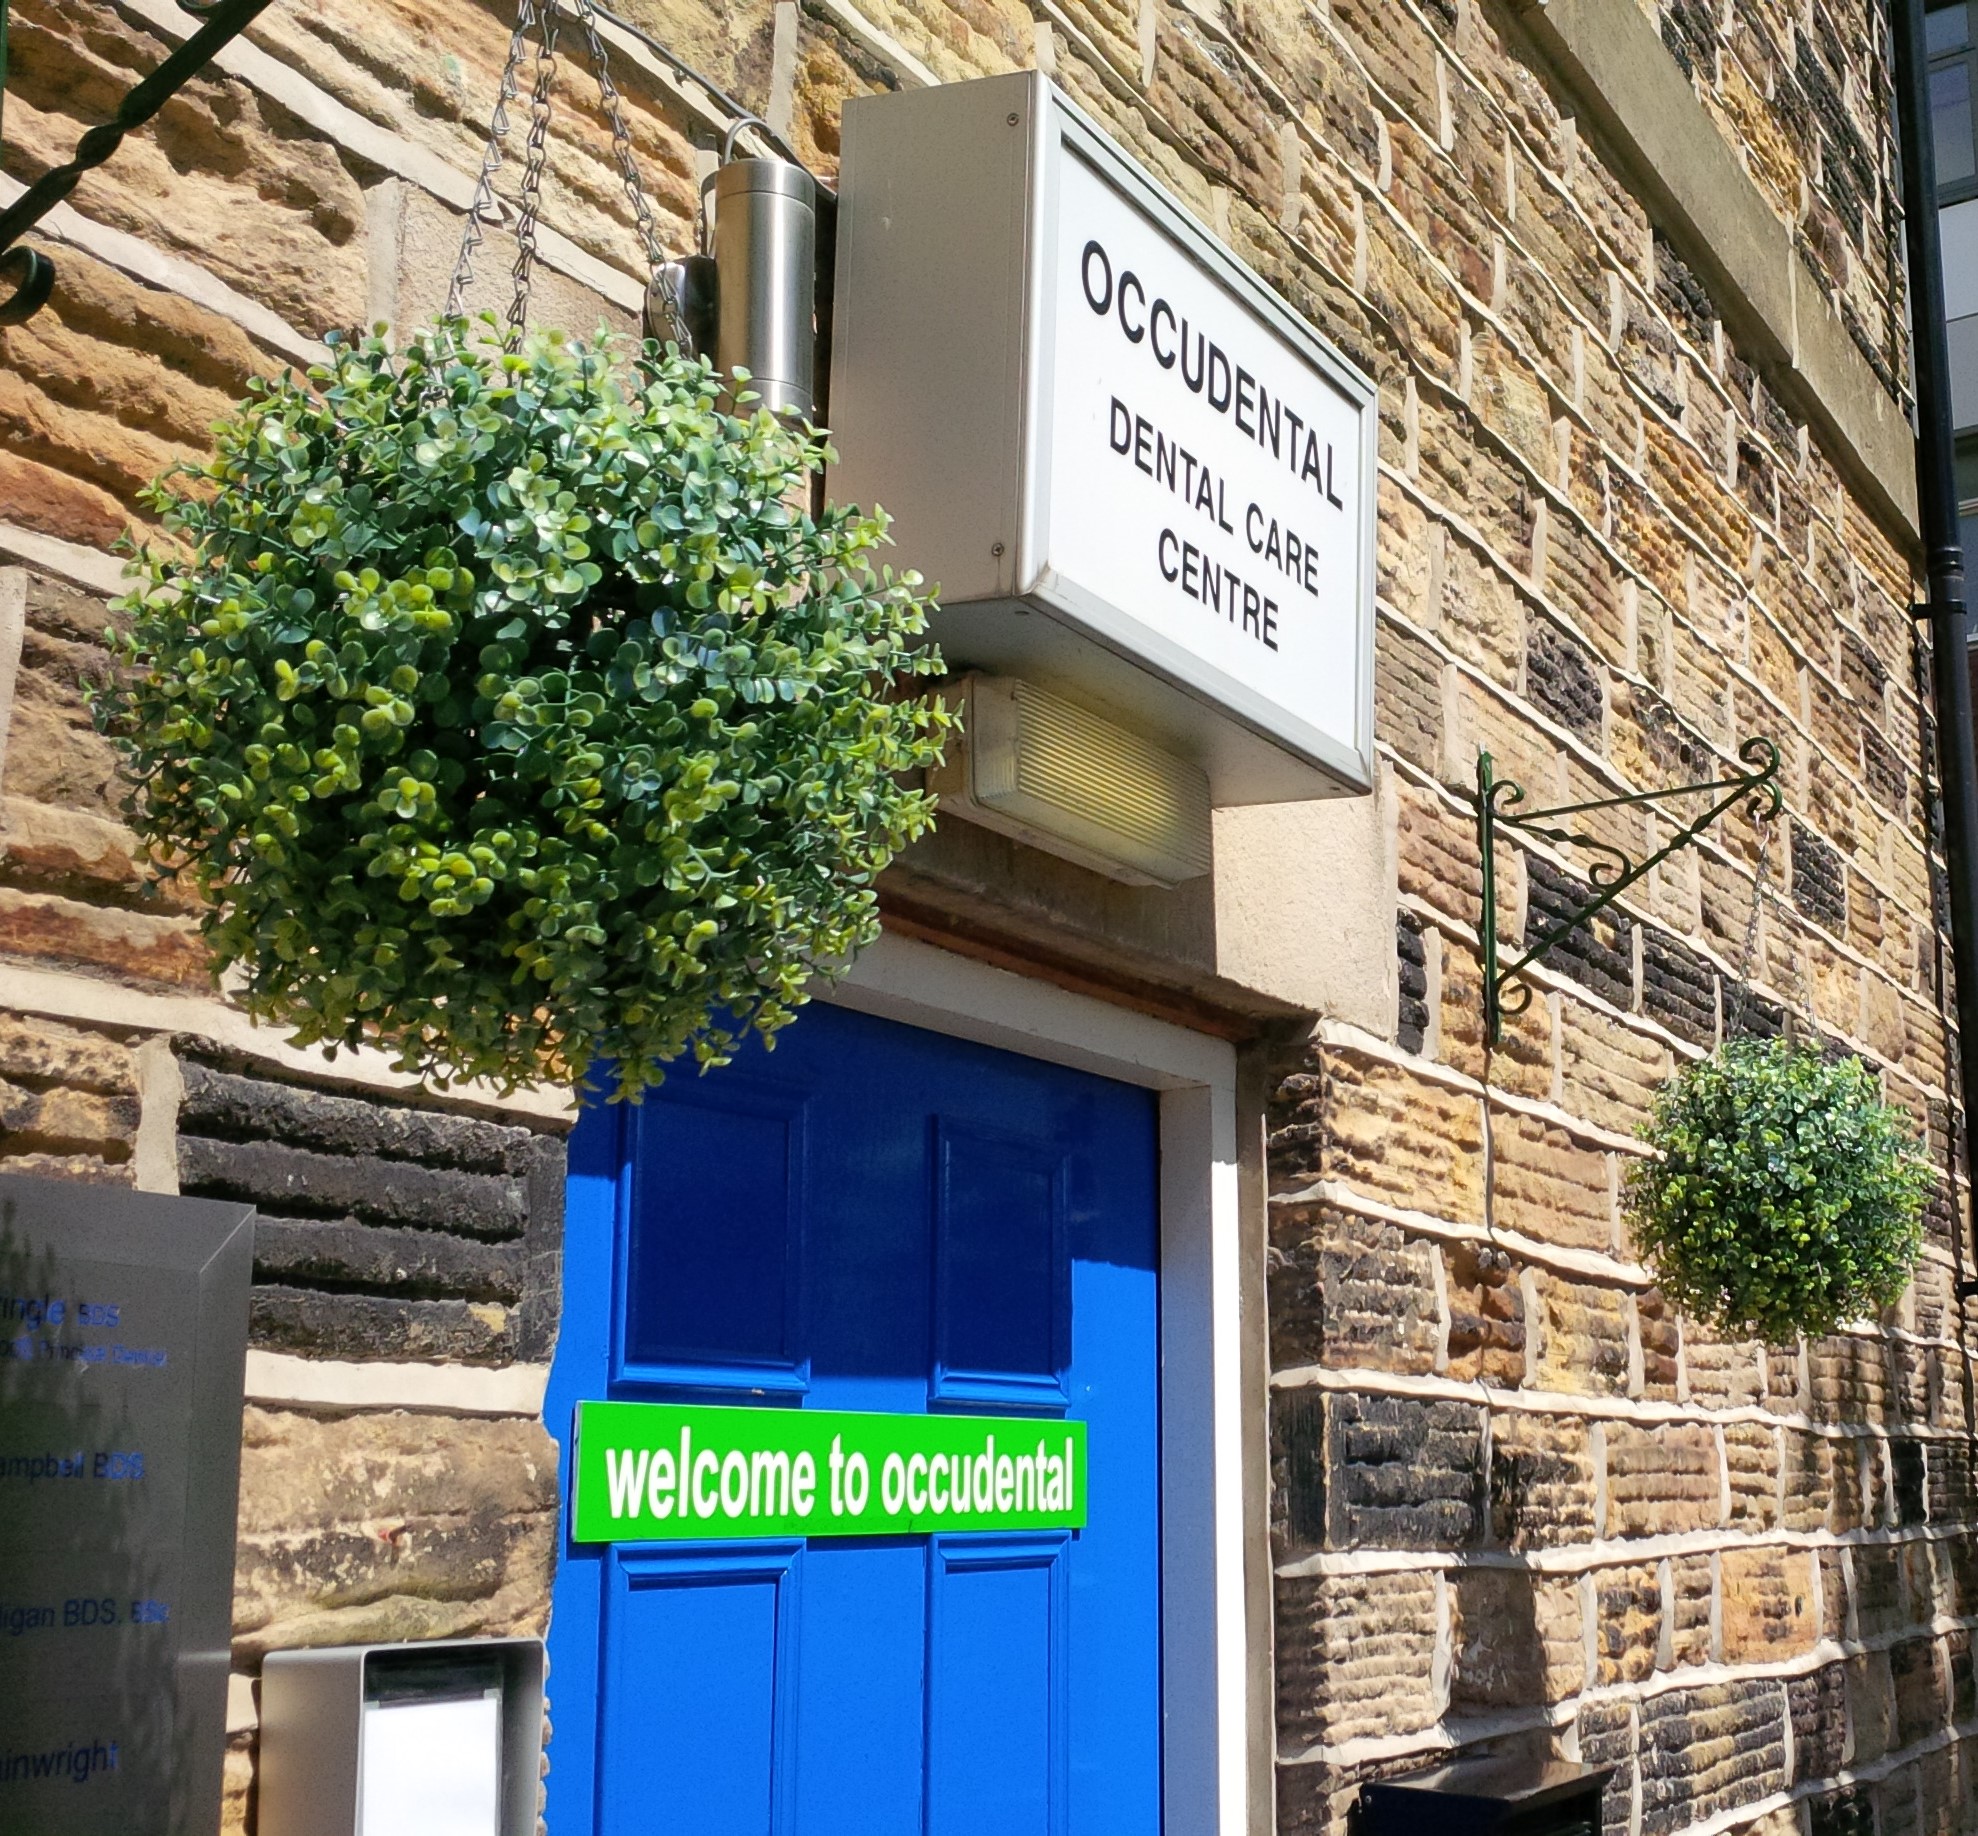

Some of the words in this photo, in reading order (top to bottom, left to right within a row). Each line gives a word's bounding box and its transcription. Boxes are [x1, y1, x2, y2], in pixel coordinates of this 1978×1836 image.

[1081, 239, 1343, 511] OCCUDENTAL
[1109, 394, 1234, 536] DENTAL
[1245, 502, 1320, 598] CARE
[1158, 527, 1279, 653] CENTRE
[93, 1451, 145, 1481] BDS
[605, 1425, 816, 1519] welcome
[828, 1432, 869, 1517] to
[880, 1434, 1074, 1515] occudental
